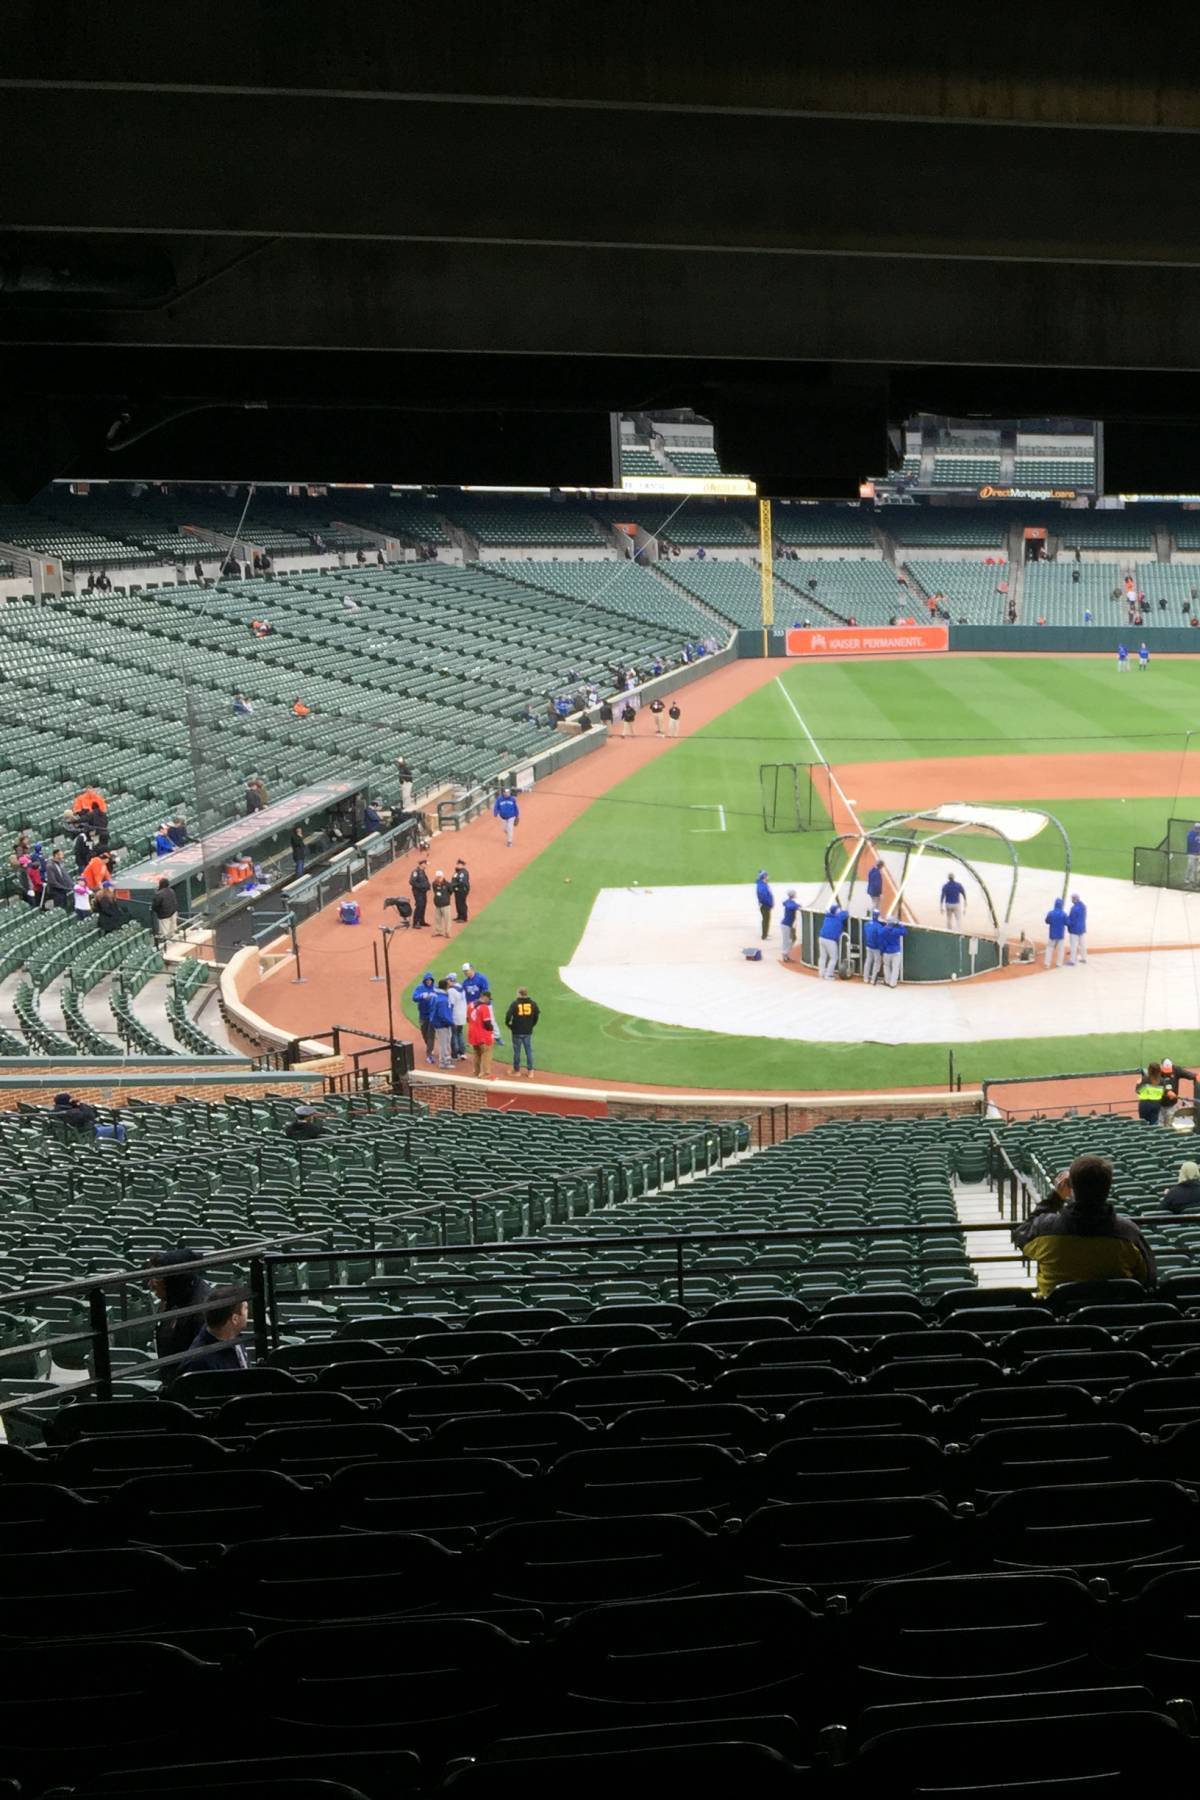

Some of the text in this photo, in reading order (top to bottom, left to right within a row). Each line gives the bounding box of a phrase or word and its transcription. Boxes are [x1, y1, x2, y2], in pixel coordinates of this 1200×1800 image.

[830, 636, 923, 649] KAISER PERMANENTE
[517, 1003, 532, 1016] 15
